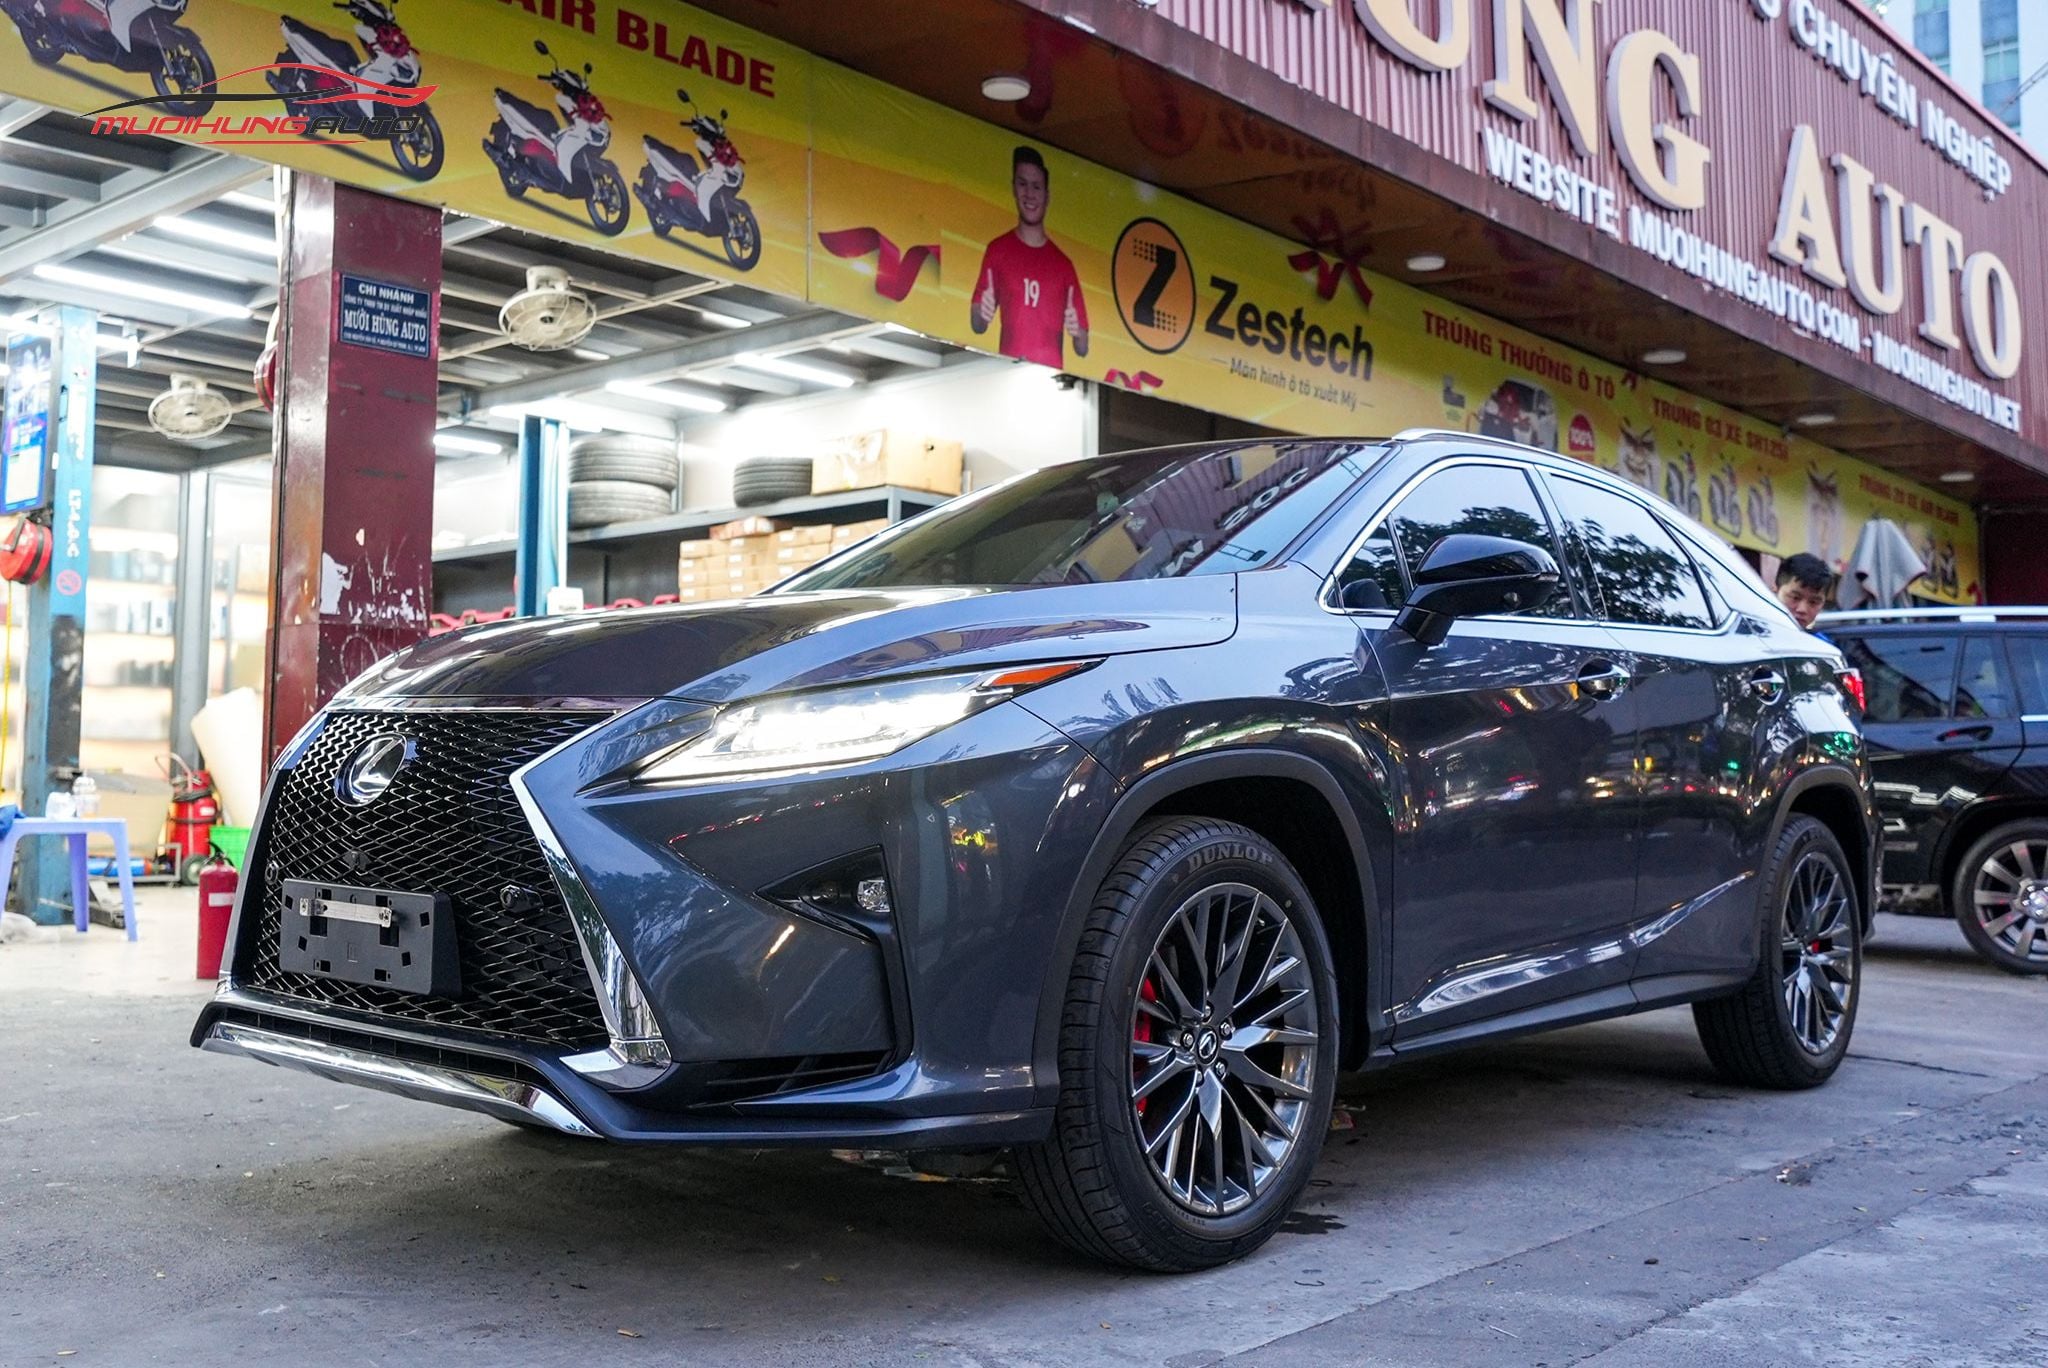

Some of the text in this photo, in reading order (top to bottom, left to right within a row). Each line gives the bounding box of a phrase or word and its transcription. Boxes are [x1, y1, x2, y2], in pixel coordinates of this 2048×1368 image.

[616, 9, 775, 99] BLADE
[1789, 0, 2013, 202] CHUYÊN NGHIỆP
[1481, 127, 1620, 241] WEBSITE:
[1768, 123, 2022, 379] AUTO
[358, 283, 377, 297] CHI
[1023, 278, 1039, 308] 19
[343, 307, 370, 332] MƯỜI
[400, 321, 427, 343] AUTO
[1204, 275, 1374, 382] Zestech
[1421, 309, 1493, 357] TRÚNG
[1187, 842, 1273, 873] DUNLOP
